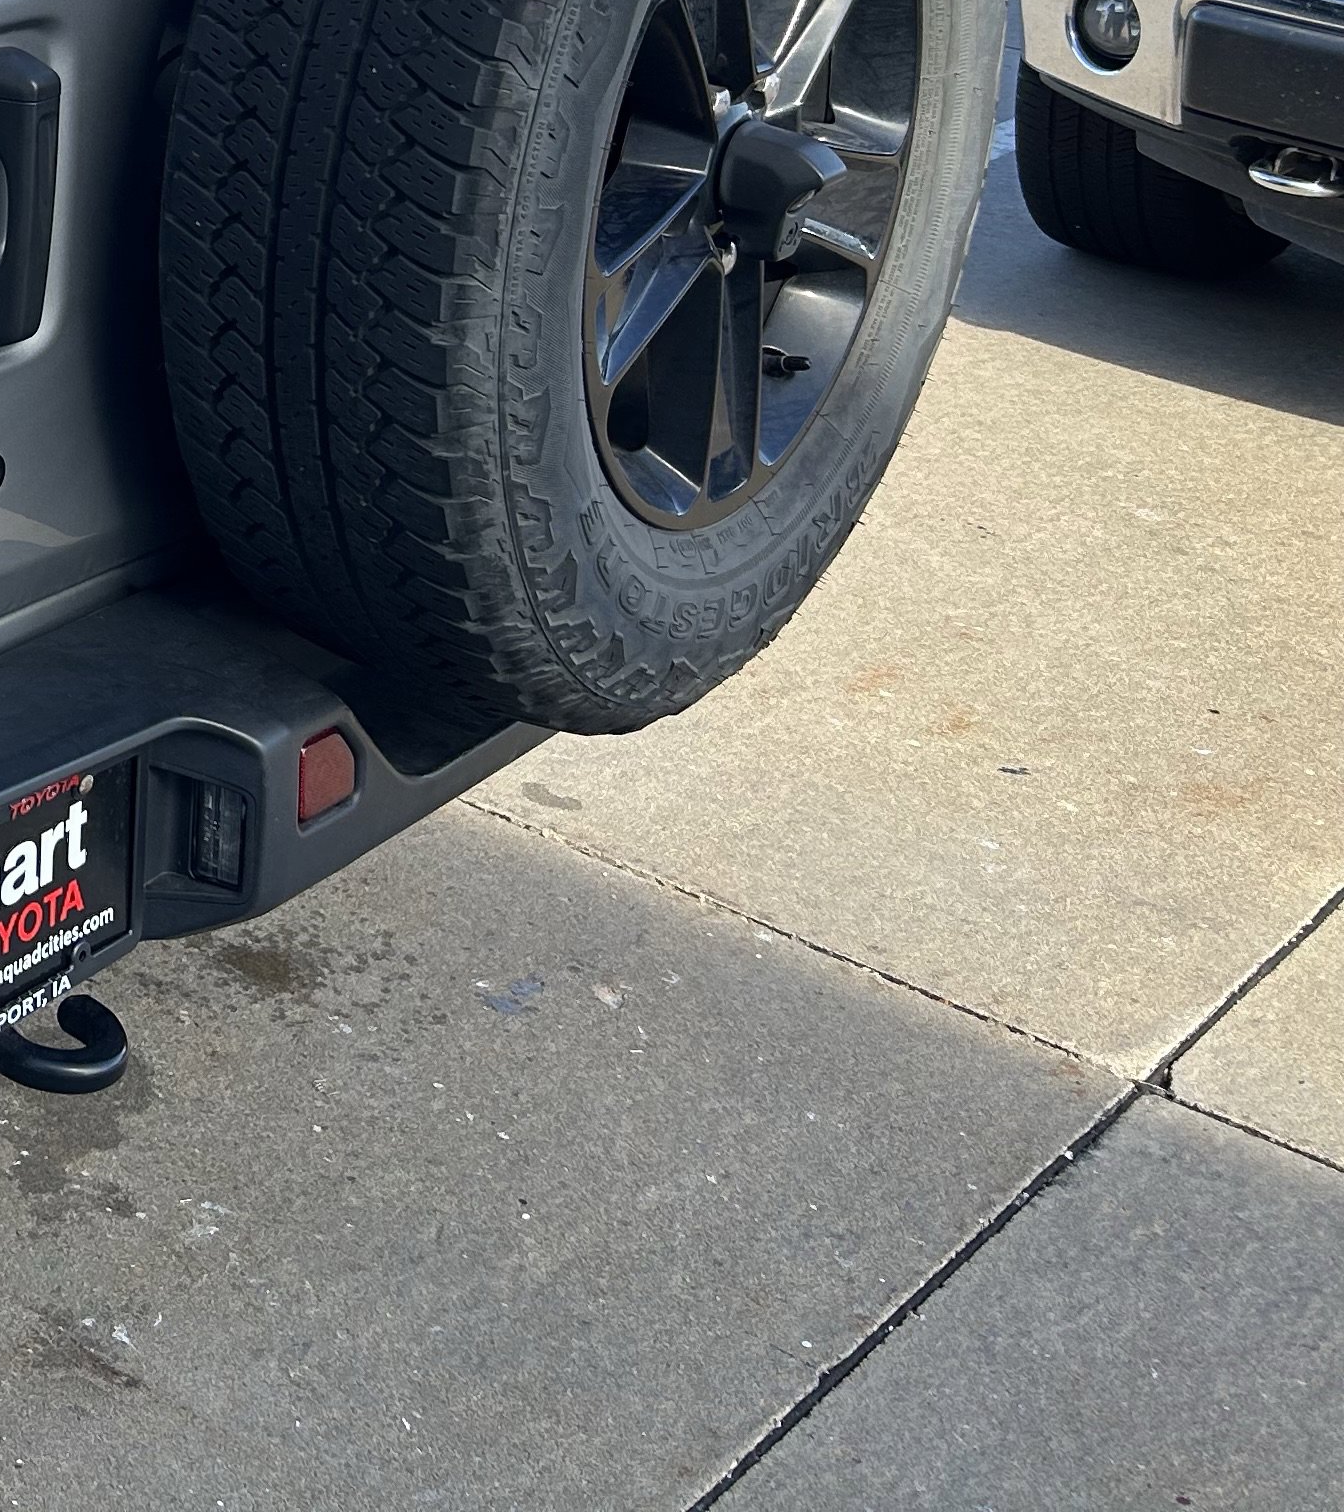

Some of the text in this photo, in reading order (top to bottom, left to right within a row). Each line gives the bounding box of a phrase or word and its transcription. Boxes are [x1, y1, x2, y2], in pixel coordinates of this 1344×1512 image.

[577, 438, 879, 641] BRIDGESTONE
[9, 774, 80, 820] TOYOTA
[51, 974, 72, 996] IA
